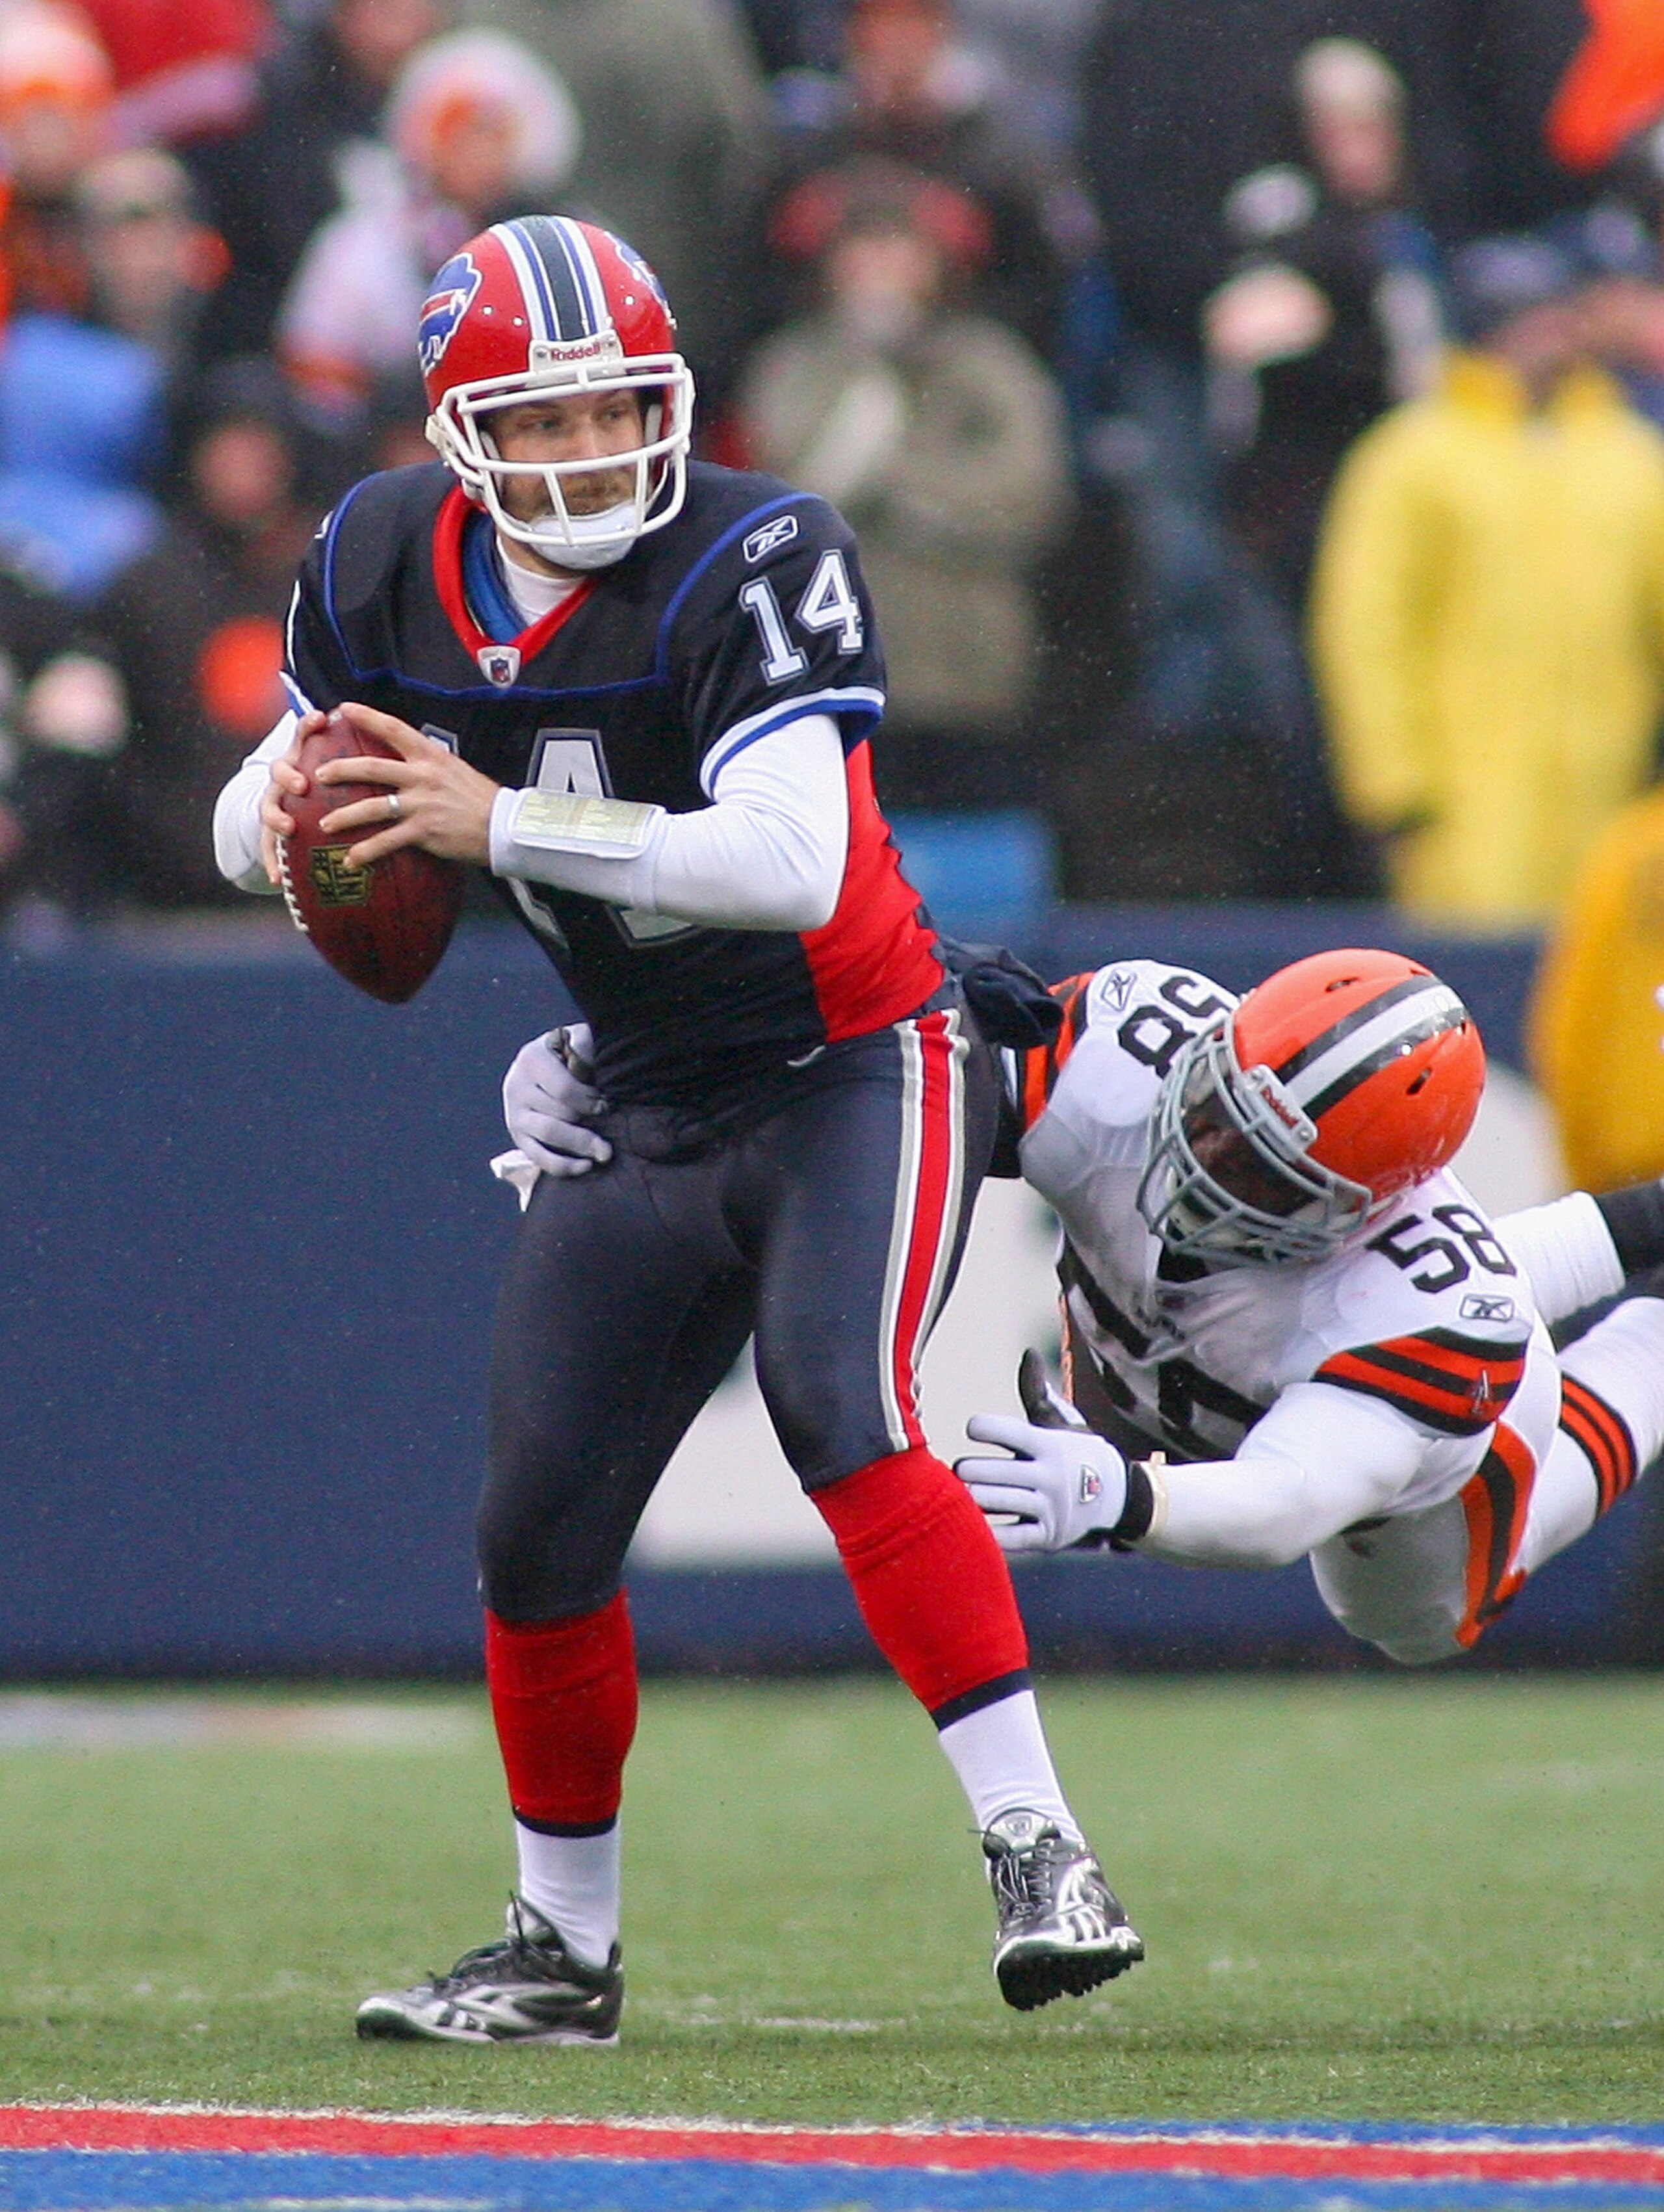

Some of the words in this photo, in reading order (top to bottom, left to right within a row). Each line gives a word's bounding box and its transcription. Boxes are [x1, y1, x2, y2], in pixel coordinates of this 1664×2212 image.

[550, 341, 601, 360] Riddell
[739, 549, 864, 685] 14
[1117, 976, 1233, 1080] 58
[1364, 1204, 1516, 1294] 58
